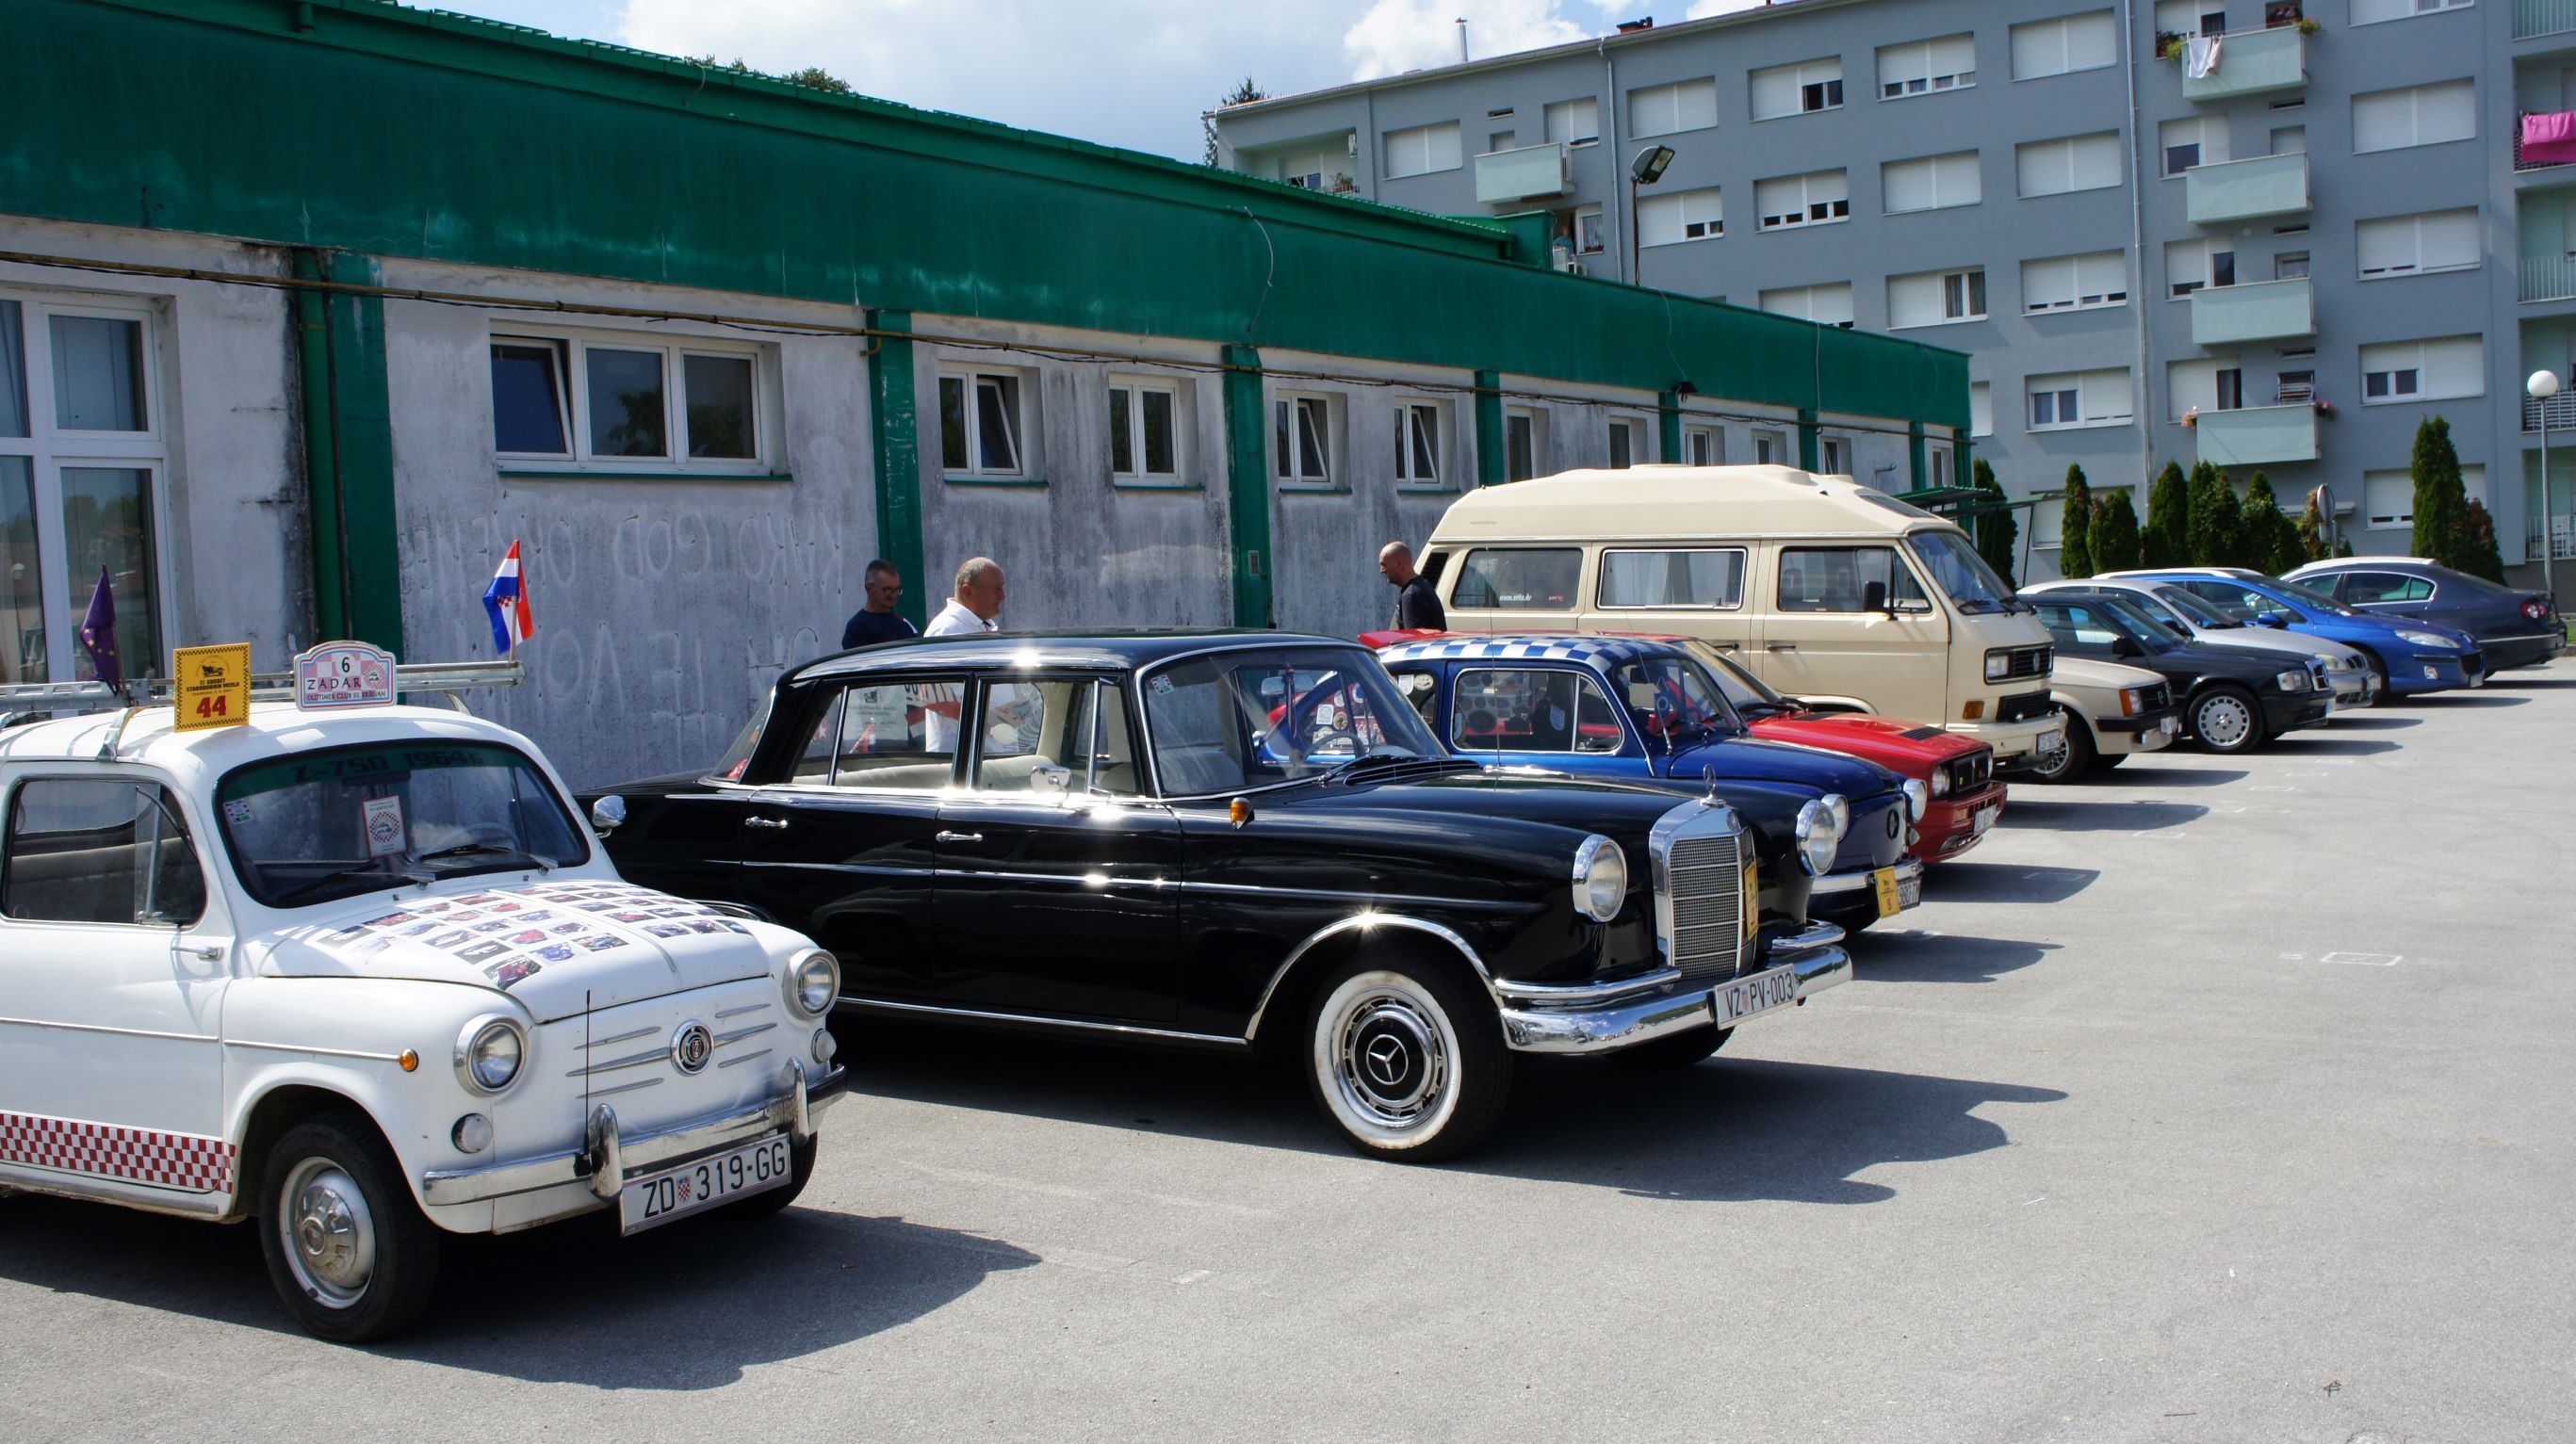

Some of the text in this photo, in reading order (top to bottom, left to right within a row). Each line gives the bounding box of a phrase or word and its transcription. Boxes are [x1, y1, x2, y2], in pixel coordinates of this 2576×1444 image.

[341, 657, 351, 673] 6
[307, 676, 362, 690] ZADAR
[196, 695, 227, 719] 44
[307, 692, 335, 702] OLDTIMER
[336, 691, 351, 700] CLUB
[291, 754, 390, 784] Z-750
[1749, 971, 1794, 1012] PV-003
[643, 1141, 786, 1219] ZD 319-GG
